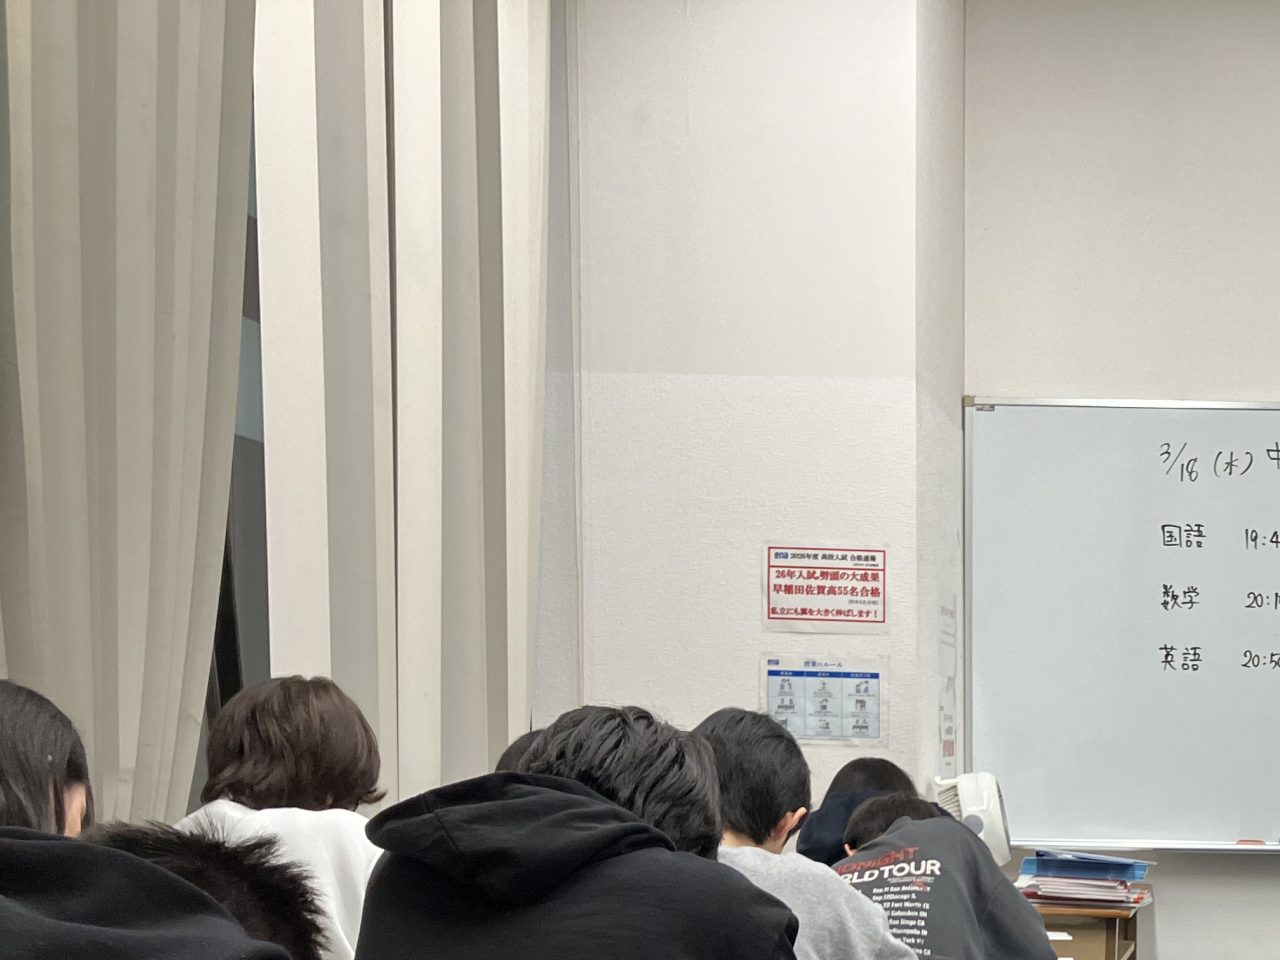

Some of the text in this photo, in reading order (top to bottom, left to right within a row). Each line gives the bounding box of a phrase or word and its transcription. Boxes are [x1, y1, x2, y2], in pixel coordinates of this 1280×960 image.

[1161, 523, 1206, 548] 国語
[1161, 584, 1199, 611] 数学
[1159, 644, 1203, 671] 英語
[881, 859, 941, 879] TOUR
